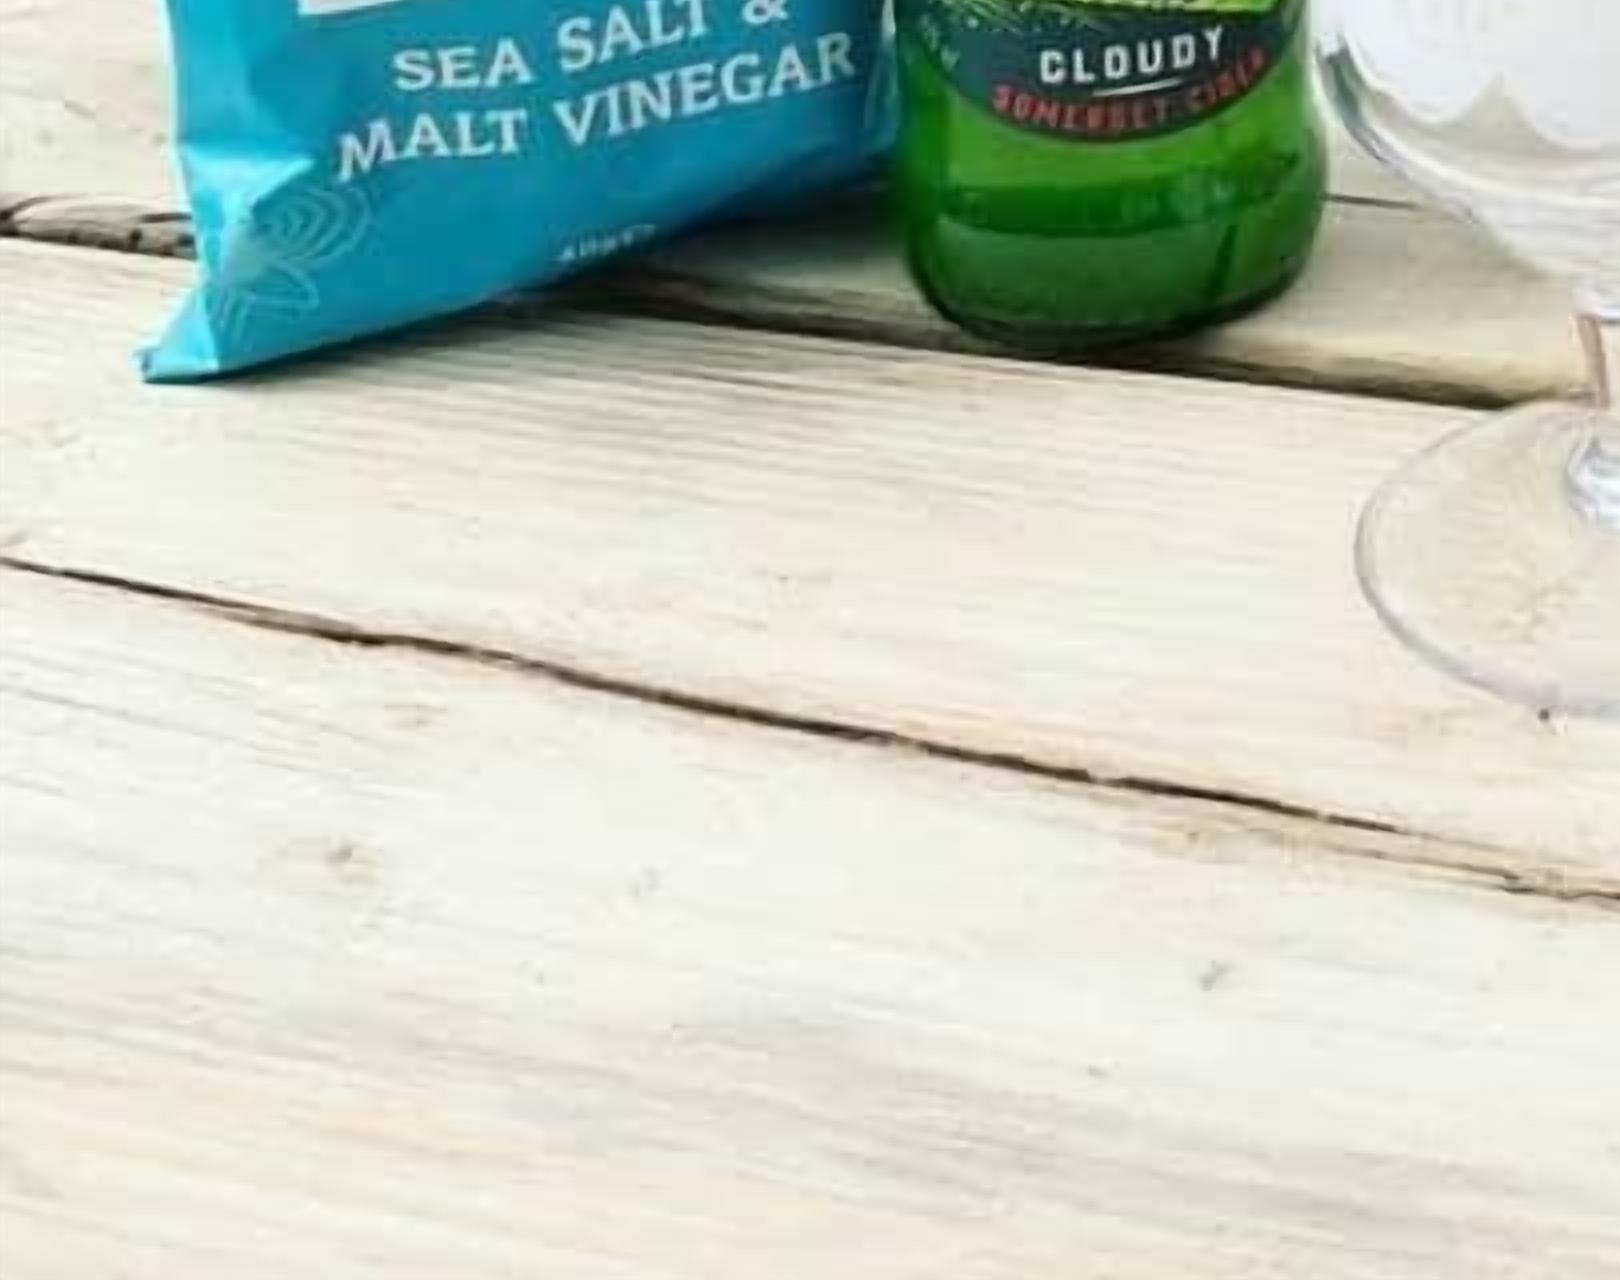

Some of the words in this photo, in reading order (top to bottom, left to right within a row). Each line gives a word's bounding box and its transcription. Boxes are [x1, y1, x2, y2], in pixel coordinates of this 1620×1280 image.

[392, 27, 535, 92] SEA
[1039, 27, 1225, 84] CLOUDY
[338, 107, 527, 183] MALT
[555, 31, 858, 146] VINEGAR
[991, 83, 1170, 131] SOMERSET
